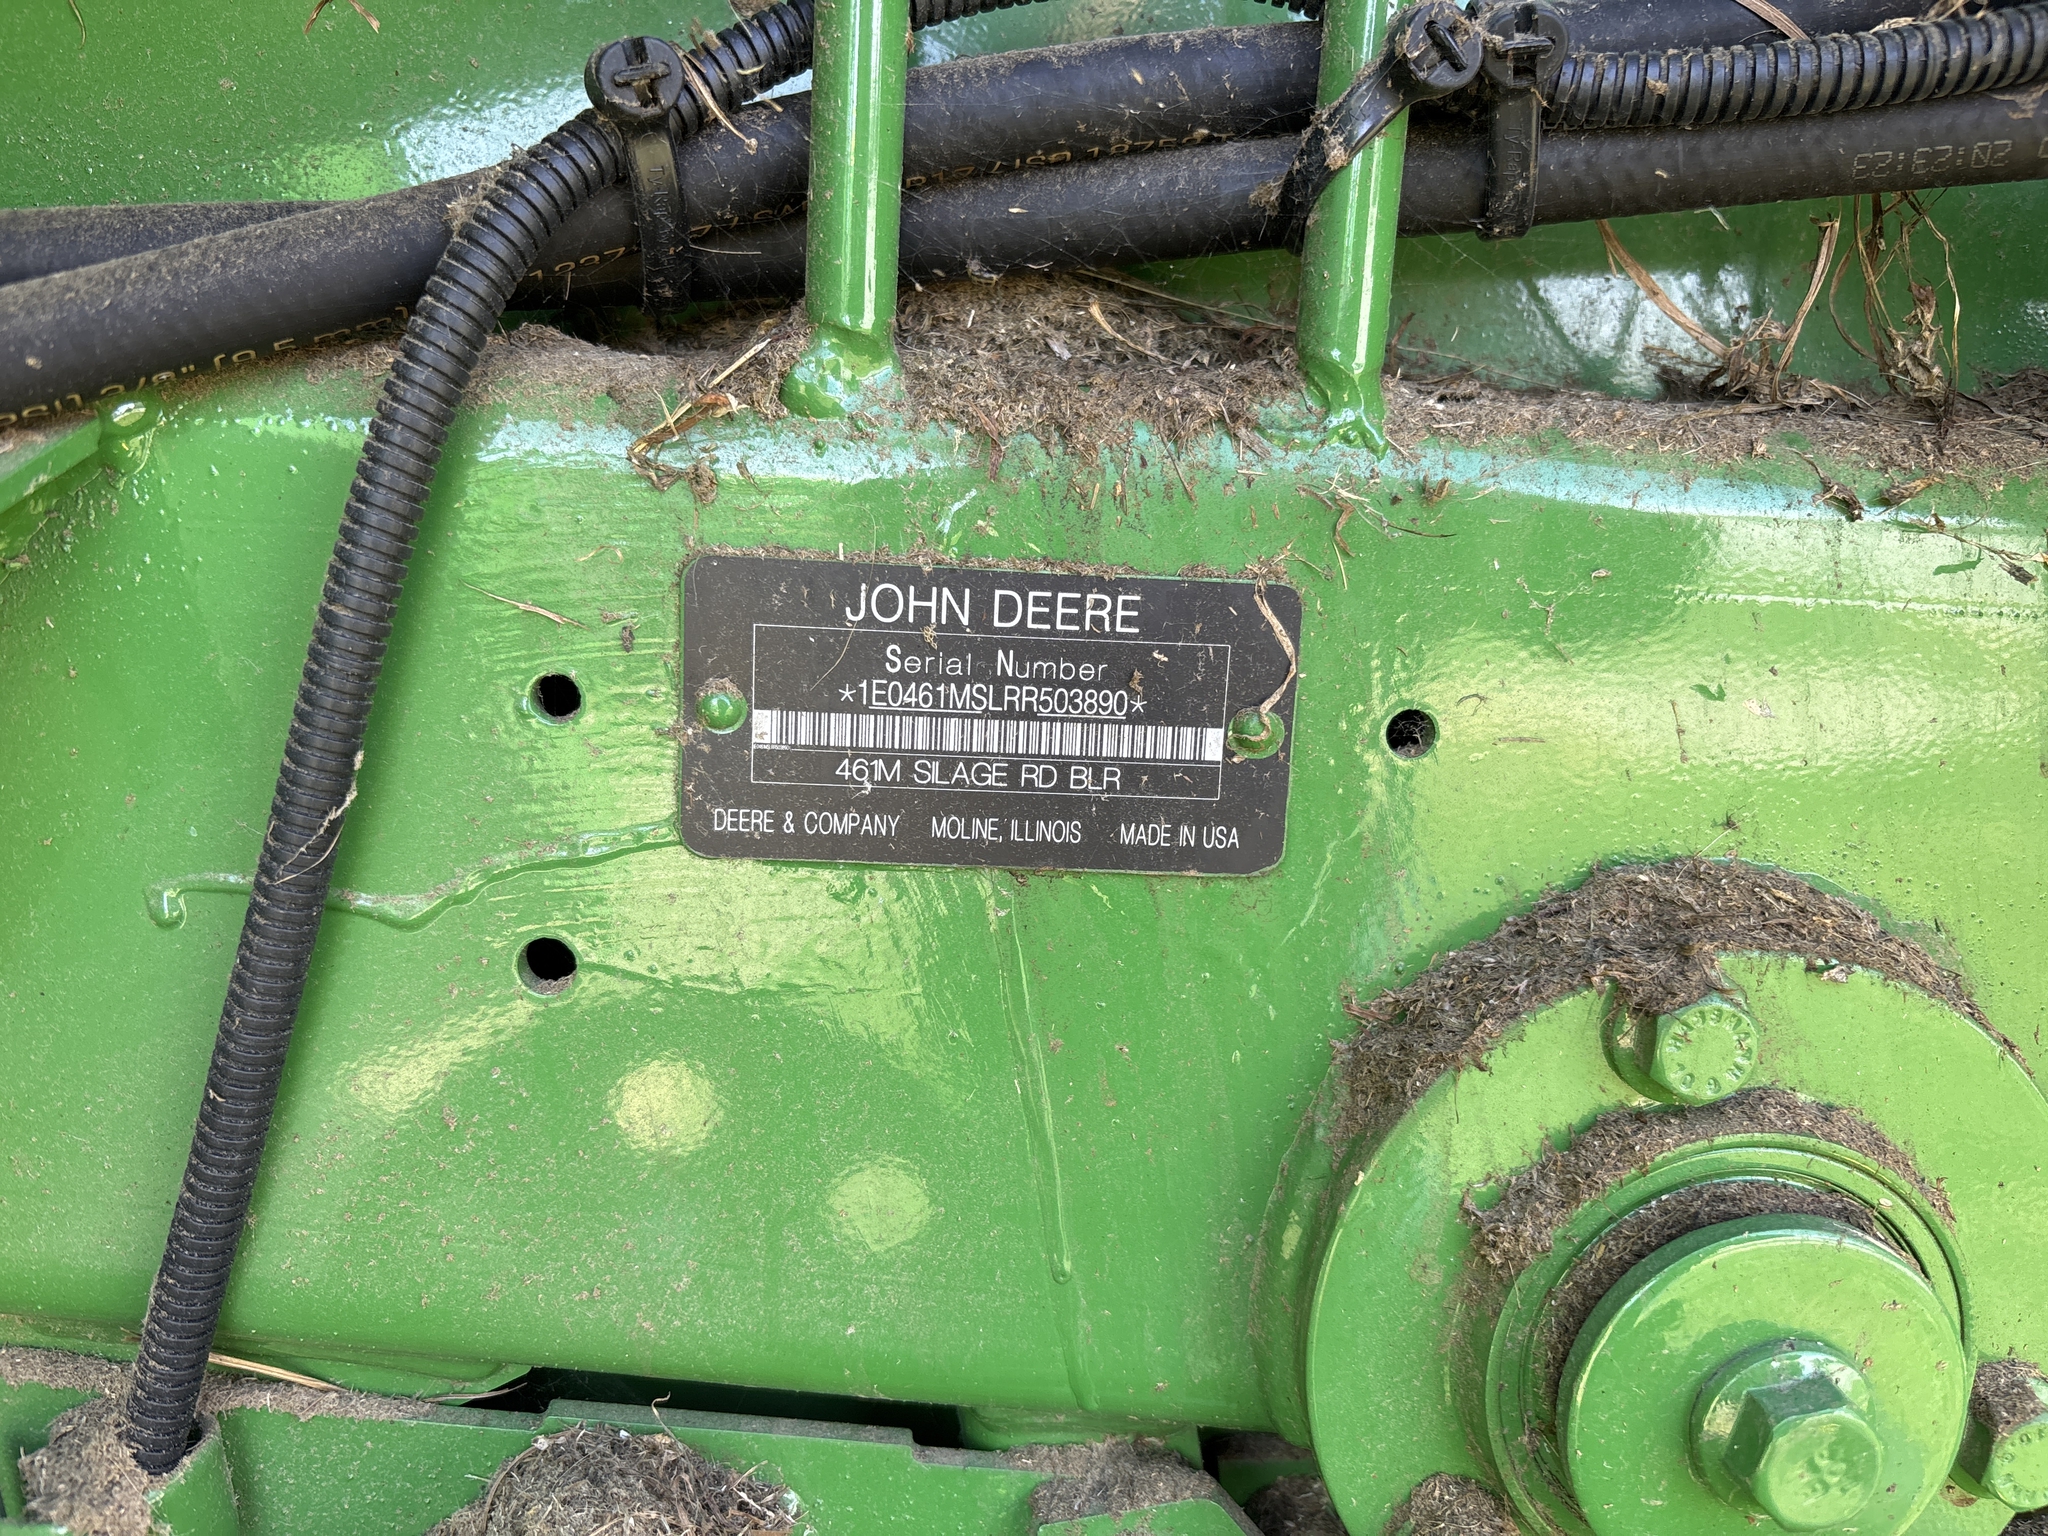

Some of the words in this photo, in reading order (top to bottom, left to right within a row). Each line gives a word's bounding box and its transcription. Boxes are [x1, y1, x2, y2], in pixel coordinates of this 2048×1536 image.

[1851, 139, 2012, 179] 20:23:23
[845, 583, 970, 625] JOHN
[992, 589, 1141, 633] DEERE
[885, 644, 972, 676] Serial
[996, 650, 1109, 681] Number
[834, 758, 901, 783] 461M
[913, 760, 1009, 788] SILAGE
[1021, 764, 1058, 788] RD
[1069, 766, 1121, 791] BLR
[713, 808, 775, 833] DEERE
[783, 810, 796, 834] &
[803, 811, 901, 837] COMPANY
[931, 816, 1003, 843] MOLINE,
[1010, 820, 1082, 844] ILLINOIS
[1119, 823, 1172, 847] MADE
[1179, 824, 1196, 848] IN
[1202, 826, 1240, 850] USA
